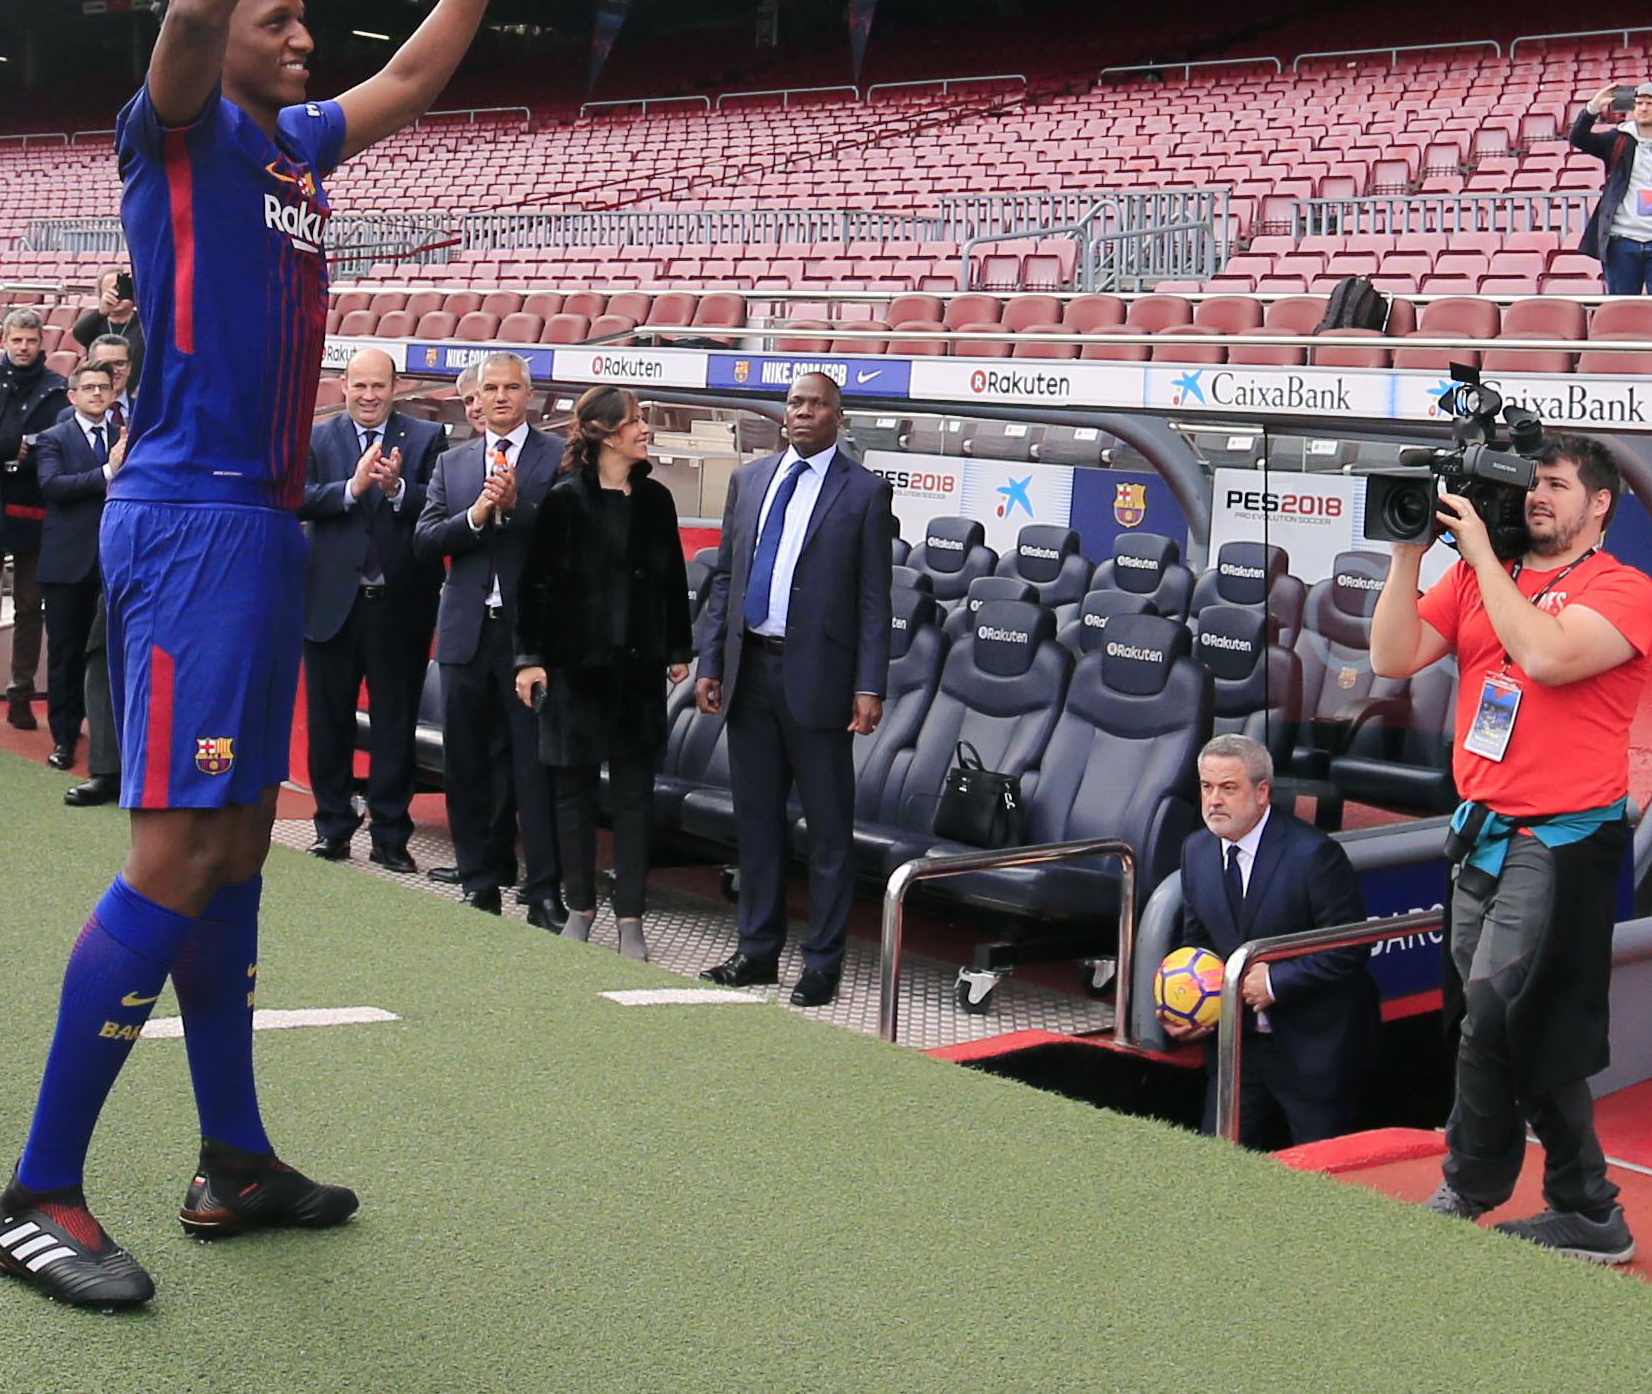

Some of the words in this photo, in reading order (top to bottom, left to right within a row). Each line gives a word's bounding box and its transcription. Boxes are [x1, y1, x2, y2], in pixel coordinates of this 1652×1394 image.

[603, 356, 663, 378] Rakuten
[987, 370, 1070, 396] Rakuten
[1211, 372, 1350, 410] CaixaBank
[1298, 516, 1331, 525] SOCCER
[933, 537, 964, 551] Rakuten
[1027, 545, 1059, 560] Rakuten
[1123, 556, 1158, 570] Rakuten
[1228, 565, 1264, 579] Rakuten
[987, 626, 1028, 644] Rakuten
[1211, 635, 1252, 652] Rakuten
[1116, 643, 1163, 663] Rakuten
